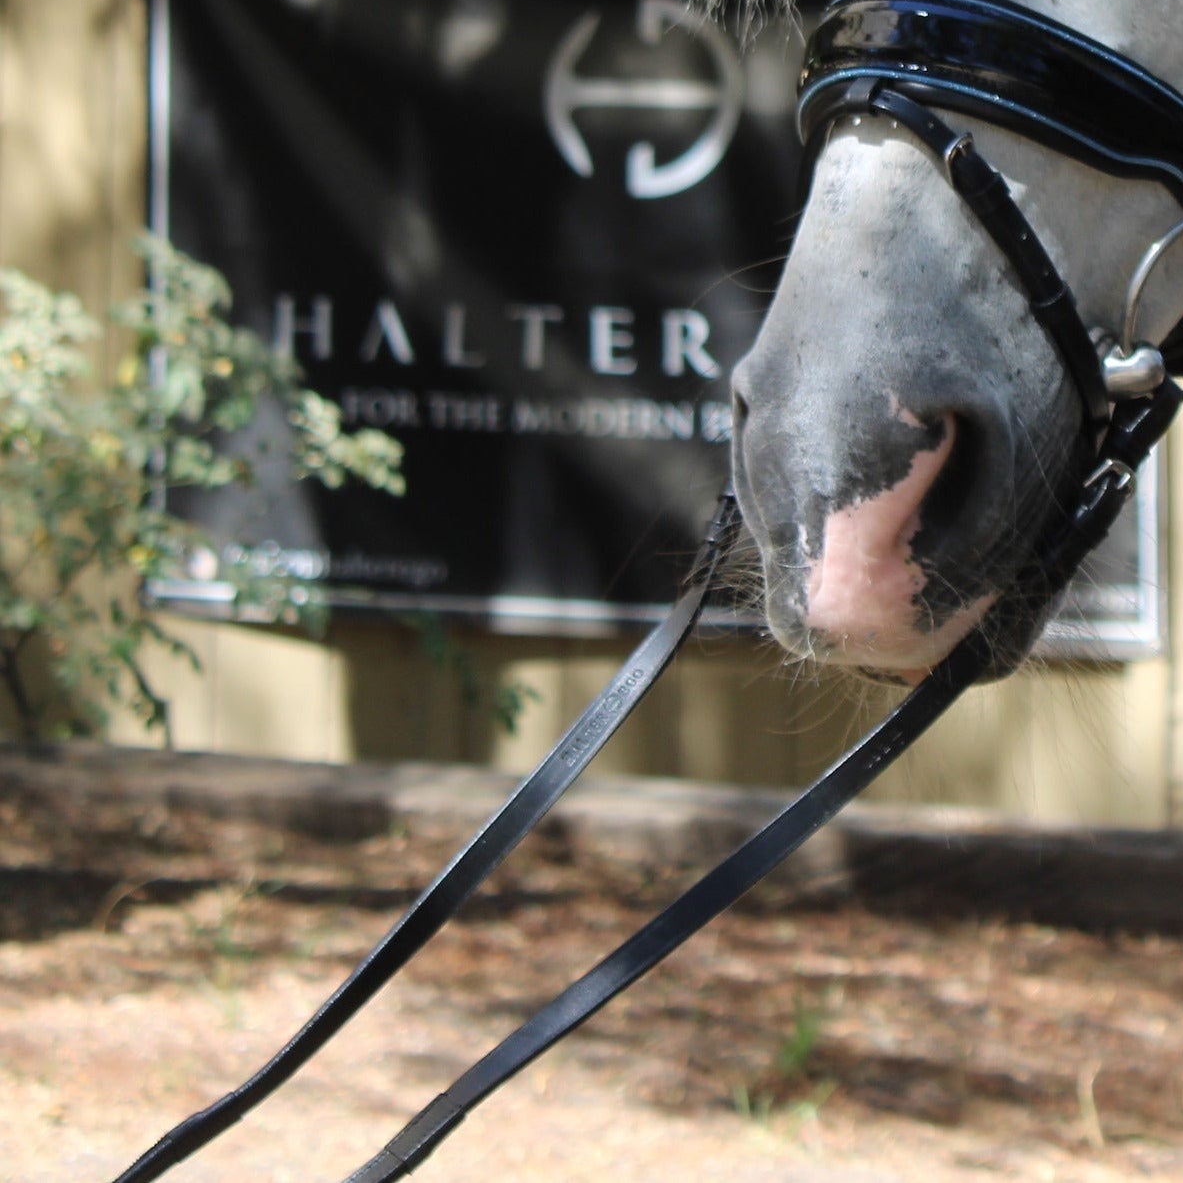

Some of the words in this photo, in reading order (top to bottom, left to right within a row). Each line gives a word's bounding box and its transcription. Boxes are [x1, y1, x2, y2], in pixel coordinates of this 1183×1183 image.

[272, 294, 722, 380] HALTER
[340, 388, 419, 428] FOR
[428, 393, 501, 433] THE
[512, 397, 694, 440] MODERN
